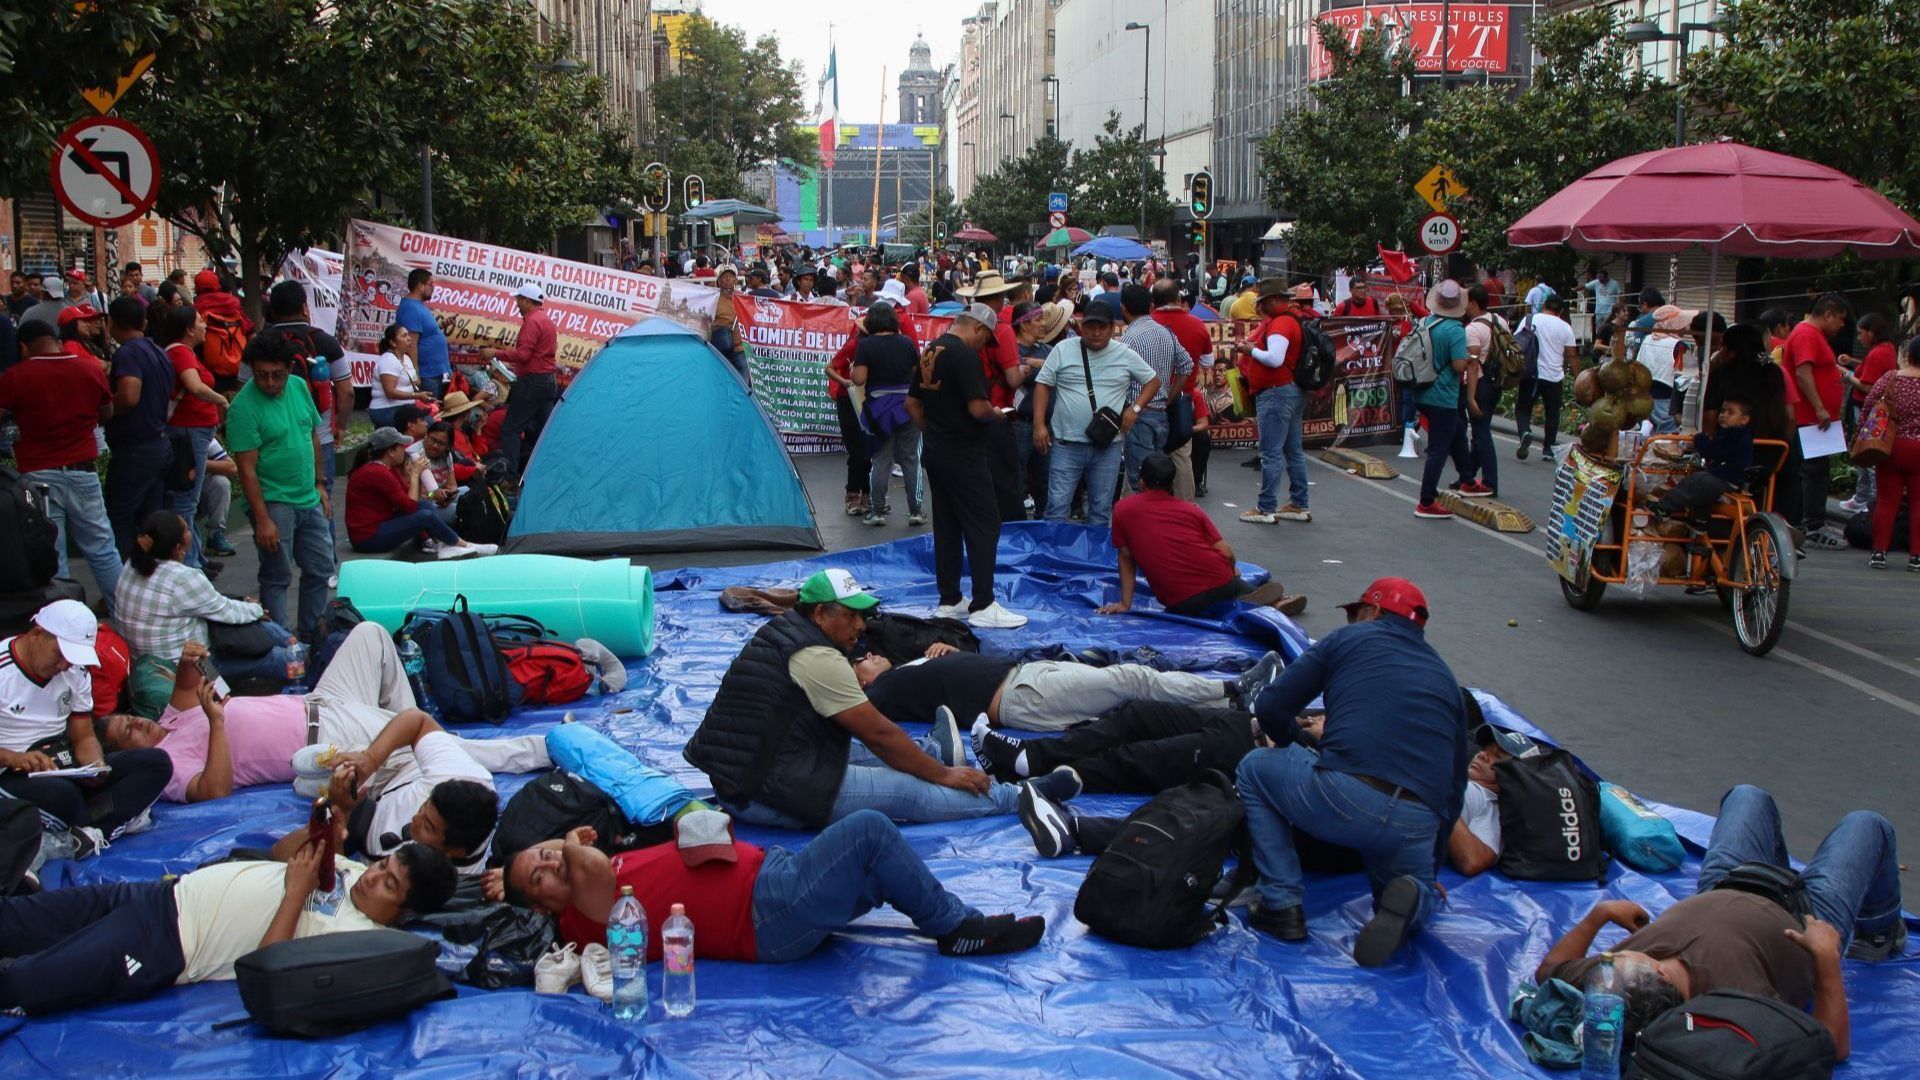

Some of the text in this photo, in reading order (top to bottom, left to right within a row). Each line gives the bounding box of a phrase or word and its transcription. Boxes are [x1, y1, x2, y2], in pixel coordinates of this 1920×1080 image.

[1460, 60, 1502, 69] COCTEL
[1429, 222, 1449, 236] 40
[1429, 237, 1449, 246] km/h
[400, 231, 464, 261] COMITÉ
[467, 245, 490, 267] DE
[493, 251, 547, 278] LUCHA
[551, 262, 658, 300] CUAUHTEPEC
[435, 261, 485, 283] ESCUELA
[545, 282, 628, 312] QUETZALCOATL
[426, 285, 510, 316] BROGACIÓN
[565, 312, 589, 332] DEL
[589, 317, 630, 339] ISSST
[749, 326, 805, 347] COMITÉ
[806, 331, 825, 350] DE
[827, 333, 850, 351] LU
[1207, 322, 1236, 343] DE
[473, 323, 494, 342] DE
[494, 325, 518, 348] AU
[559, 341, 594, 366] SALA
[752, 345, 772, 359] XIGE
[793, 366, 801, 374] A
[802, 367, 814, 375] LA
[1346, 356, 1383, 371] CNTE
[777, 397, 838, 410] SALARIAL DEL
[1348, 386, 1388, 409] 1989
[804, 411, 817, 421] DE
[1209, 427, 1254, 440] ZADOS
[1303, 420, 1336, 434] EMOS
[1559, 787, 1581, 862] adidas
